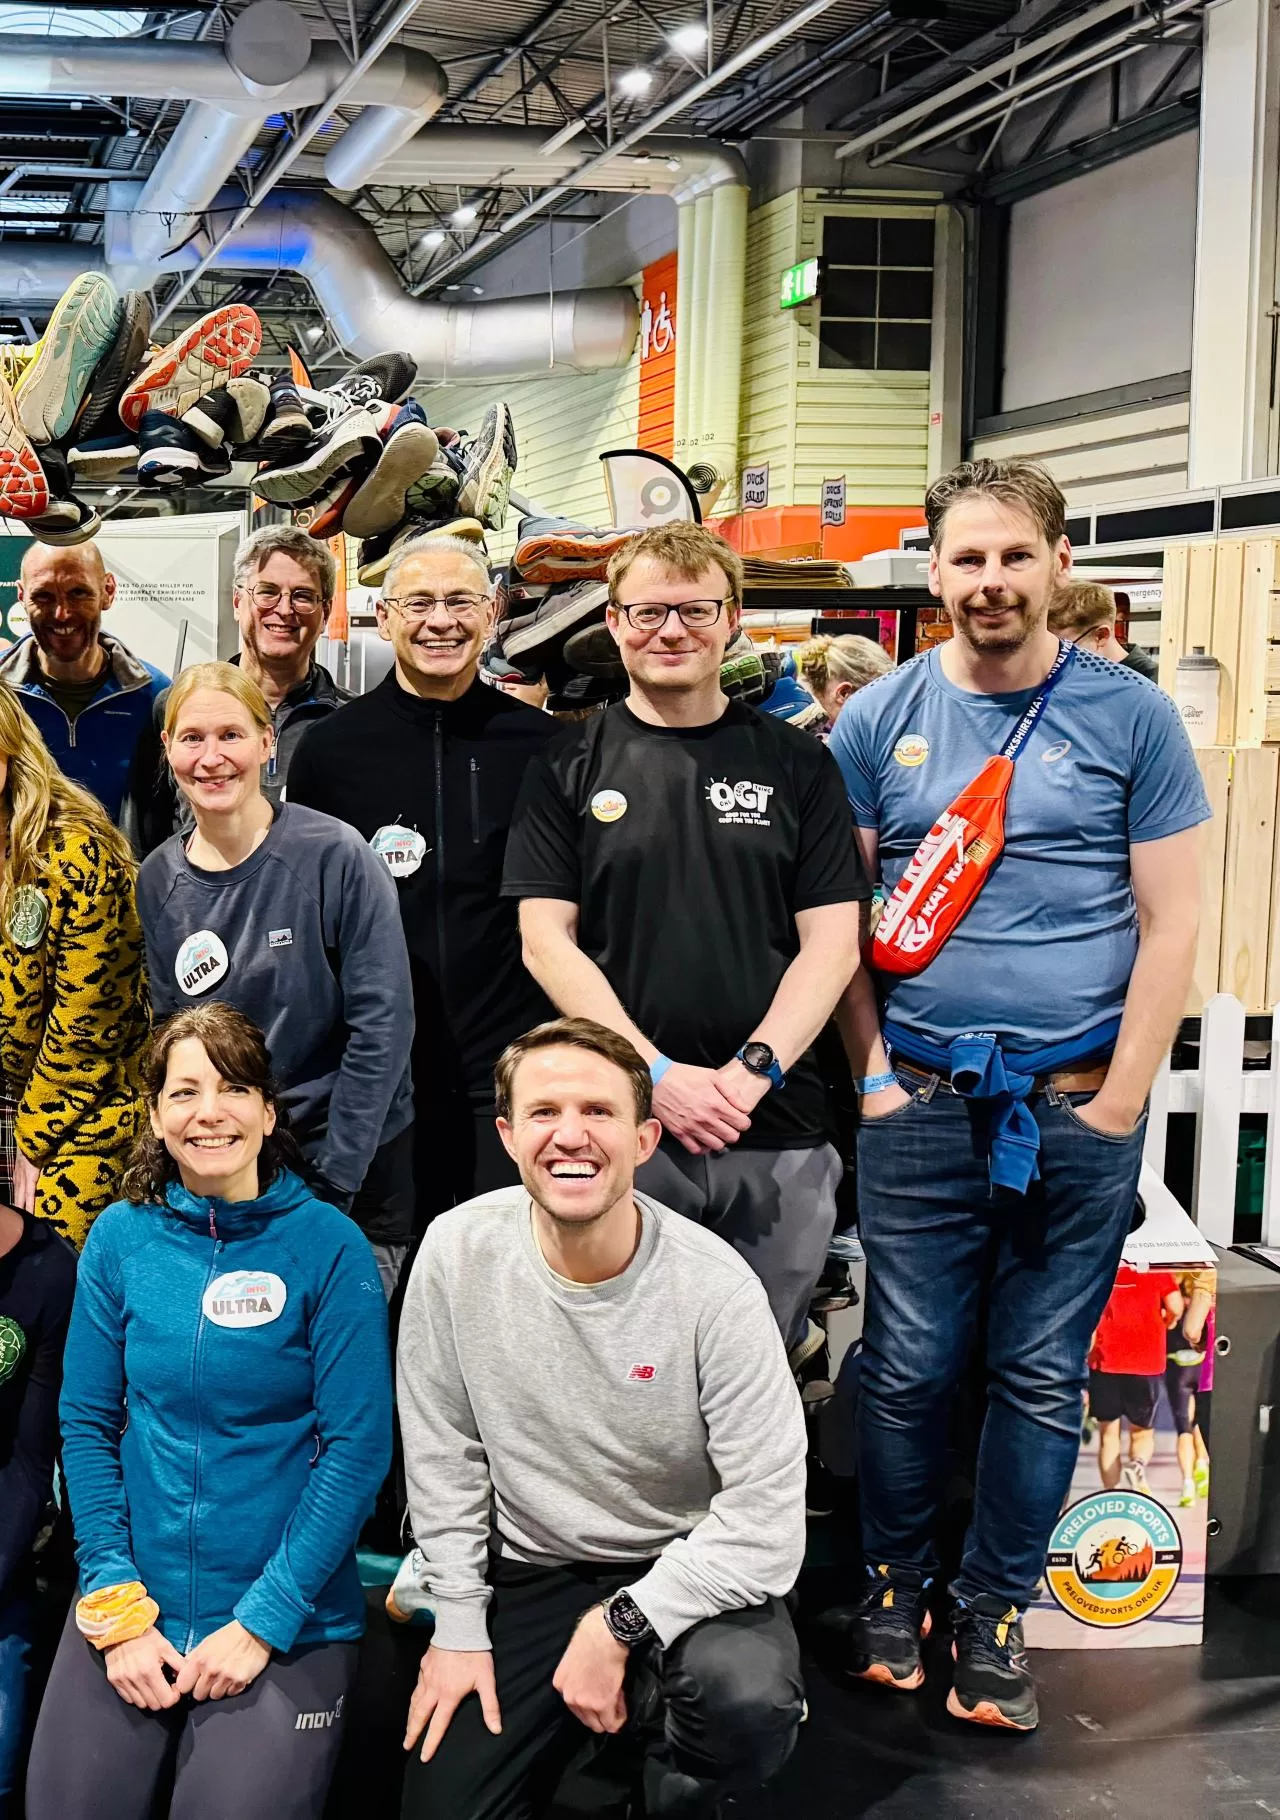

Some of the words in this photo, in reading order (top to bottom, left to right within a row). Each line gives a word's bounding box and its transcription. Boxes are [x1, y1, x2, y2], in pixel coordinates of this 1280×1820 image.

[746, 471, 765, 486] DUCK
[380, 849, 418, 864] TRA
[182, 956, 221, 989] ULTRA
[212, 1296, 273, 1316] ULTRA
[1059, 1500, 1125, 1545] PRELOVED
[1127, 1502, 1170, 1543] SPORTS
